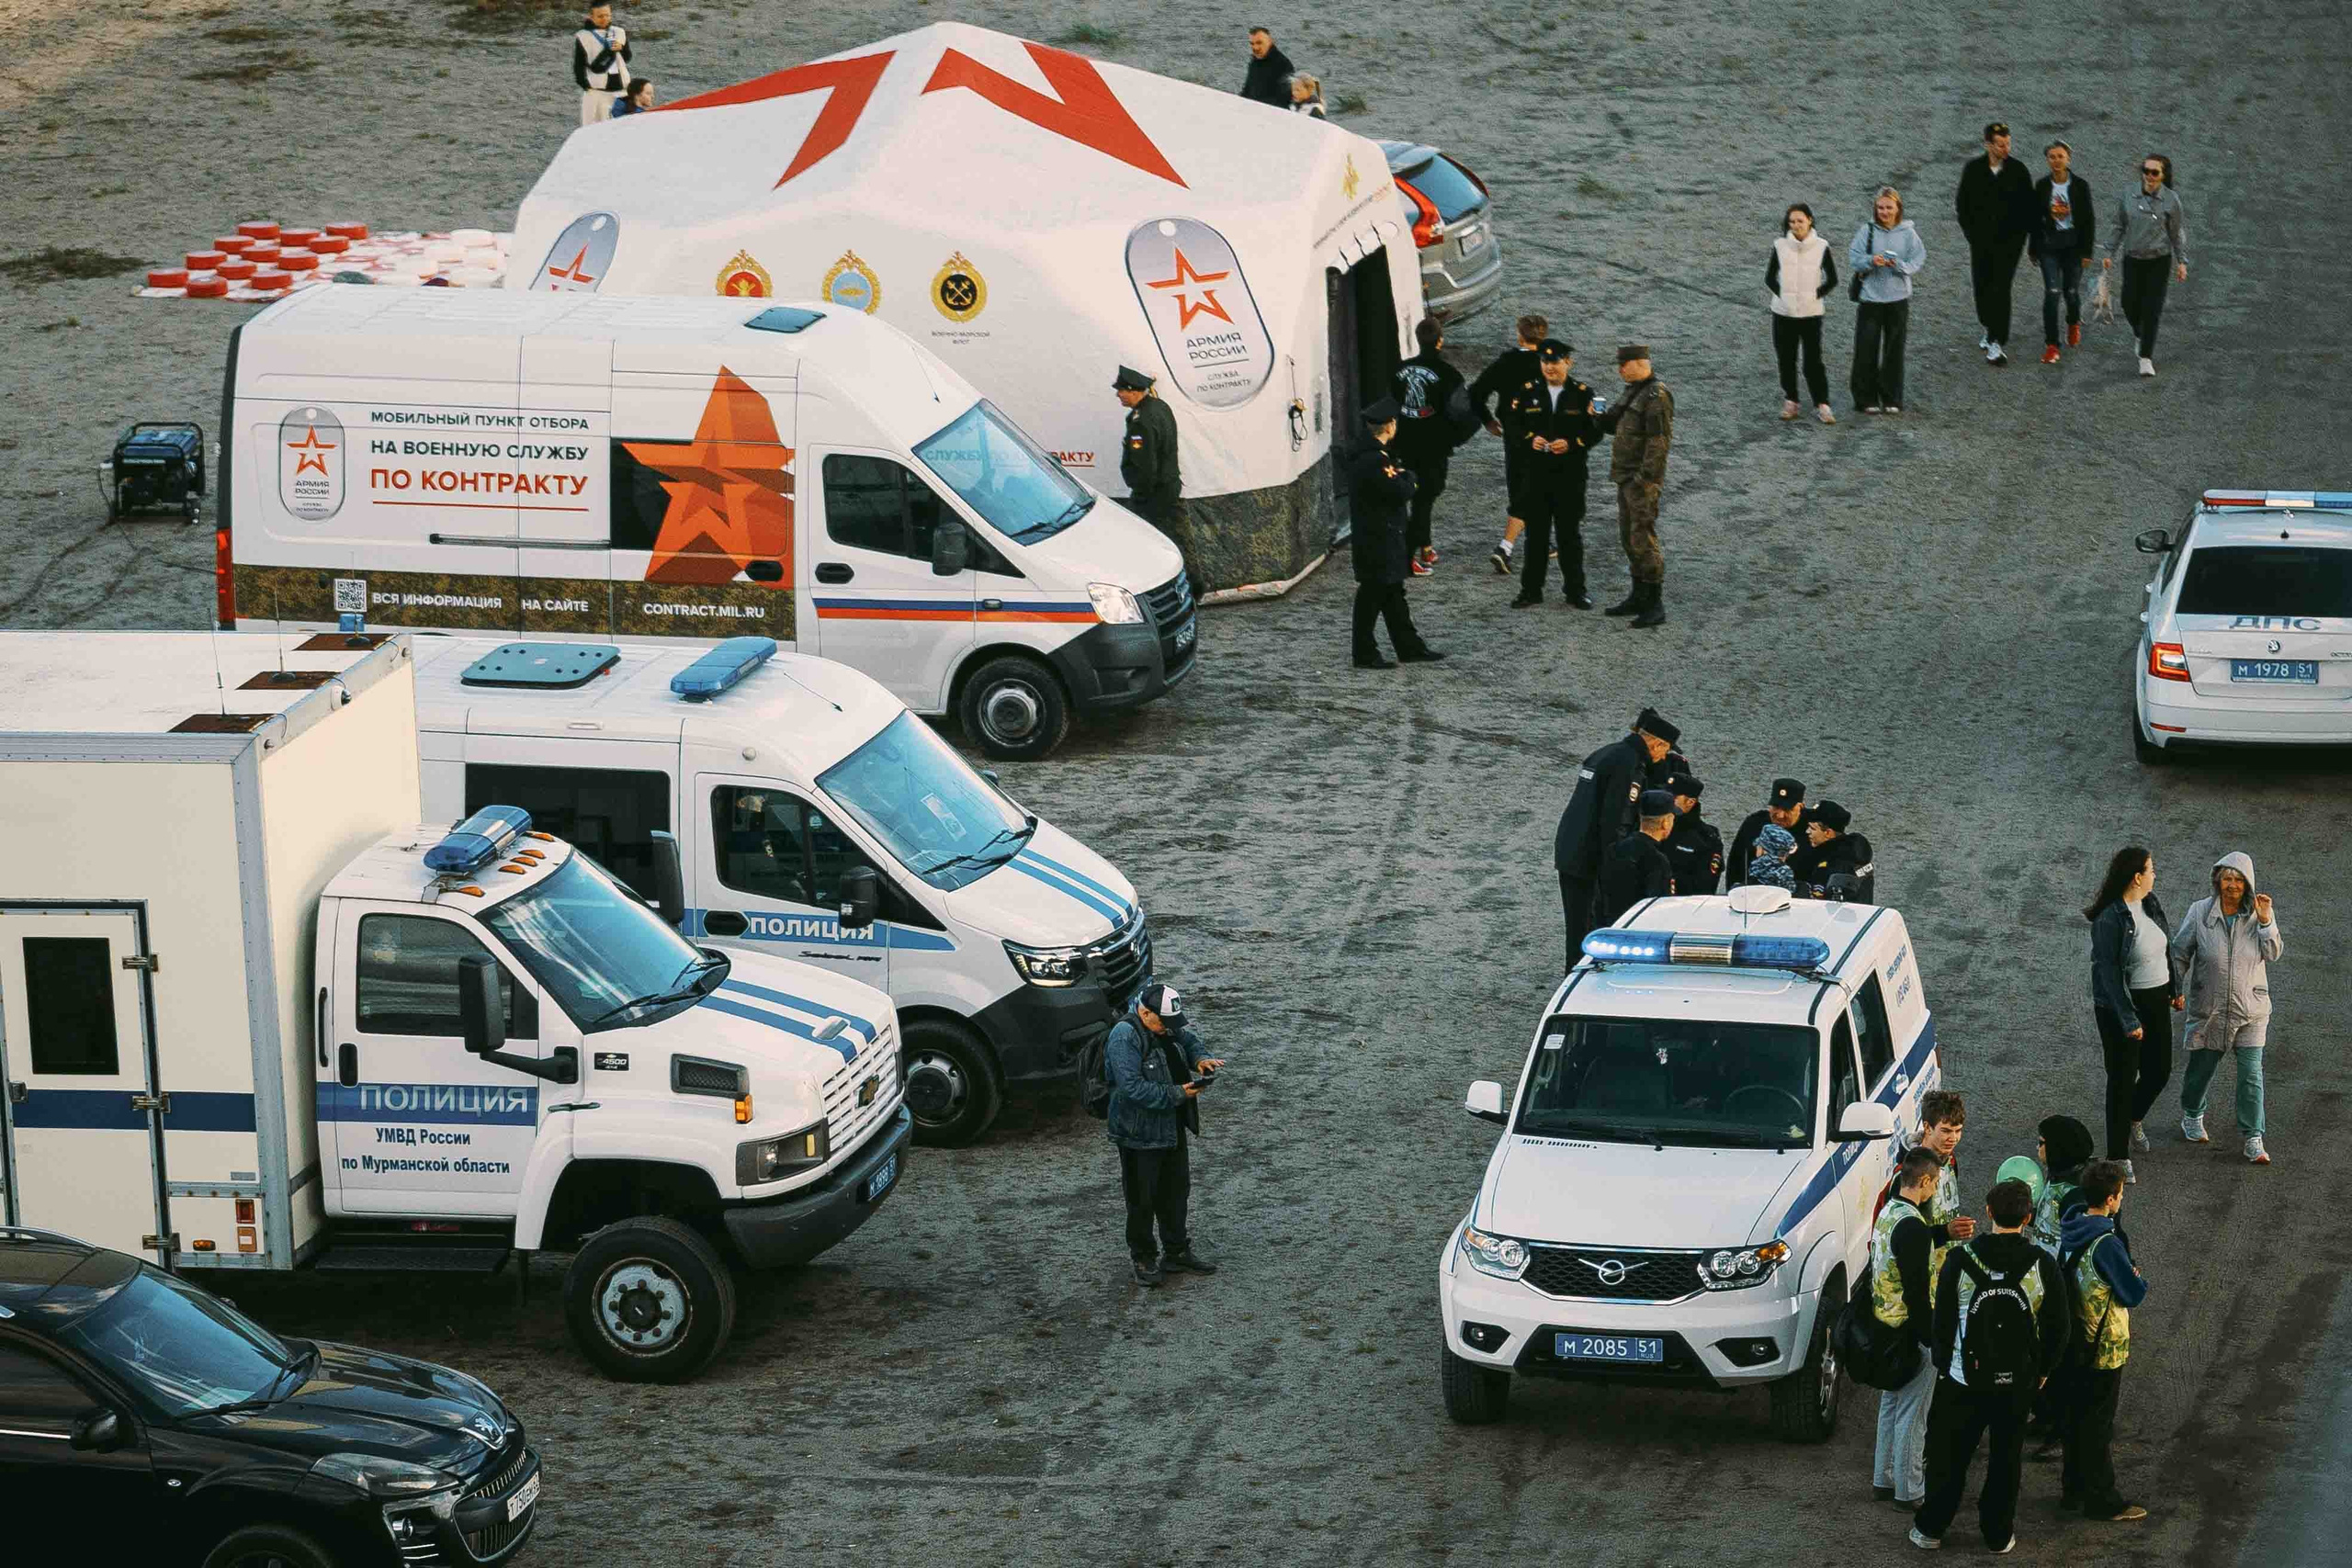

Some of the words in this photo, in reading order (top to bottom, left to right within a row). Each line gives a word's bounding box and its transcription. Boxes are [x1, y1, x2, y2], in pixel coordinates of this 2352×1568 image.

[1186, 332, 1242, 349] АРМИЯ
[1189, 344, 1248, 361] РОССИИ
[371, 411, 470, 426] МОБИЛЬНЫЙ
[475, 414, 526, 427] ПУНКТ
[529, 416, 589, 430] ОТБОРА
[371, 440, 398, 455] НА
[403, 440, 502, 457] ВОЕННУЮ
[507, 444, 589, 460] СЛУЖБУ
[296, 479, 330, 488] АРМИЯ
[371, 468, 412, 491] ПО
[421, 469, 589, 496] КОНТРАКТУ
[372, 592, 400, 605] ВСЯ
[402, 593, 502, 609] ИНФОРМАЦИЯ
[522, 599, 542, 611] НА
[546, 598, 589, 613] САЙТЕ
[643, 603, 764, 618] CONTRACT.MIL.RU
[2229, 615, 2322, 631] ДПС
[2255, 662, 2290, 677] 1978
[2298, 662, 2313, 674] 51
[750, 917, 874, 942] ПОЛИЦИЯ
[359, 1084, 528, 1117] ПОЛИЦИЯ
[376, 1127, 417, 1146] УМВД
[420, 1129, 471, 1145] России
[342, 1157, 358, 1170] по
[362, 1155, 449, 1174] Мурманской
[453, 1157, 511, 1174] области
[1970, 1291, 1988, 1314] WORLD
[1582, 1338, 1627, 1357] 2085
[1638, 1340, 1656, 1354] 51
